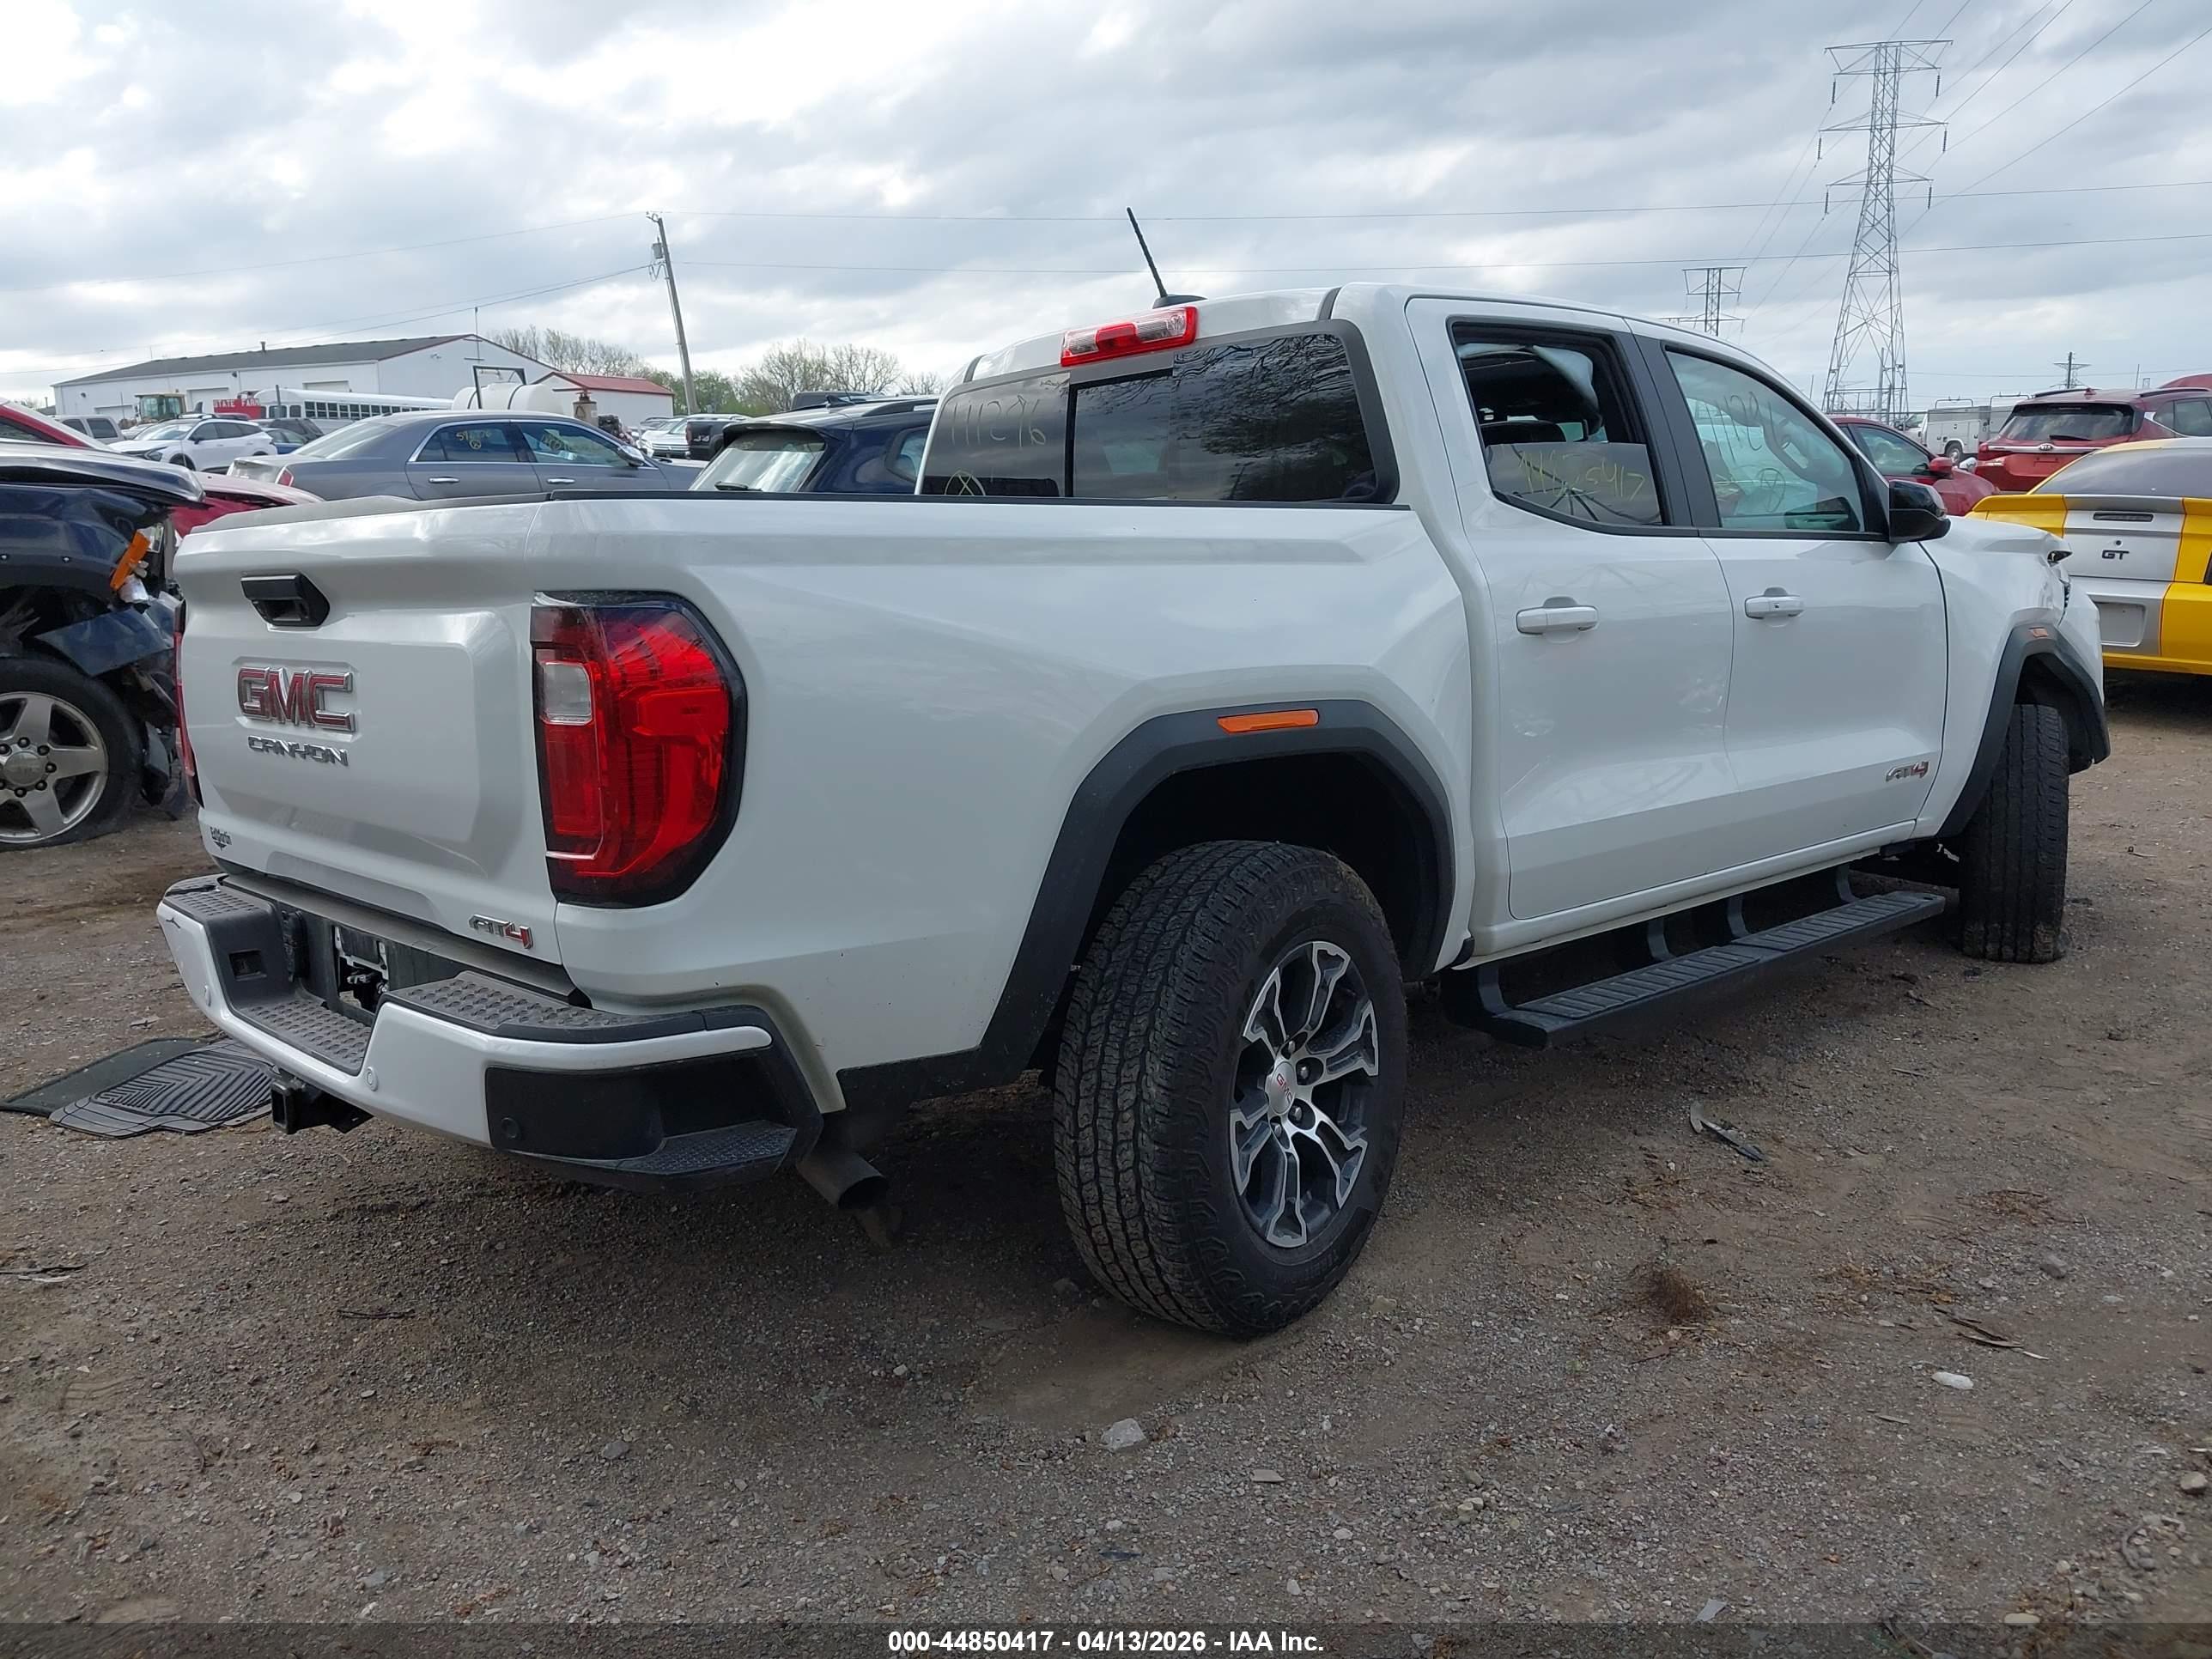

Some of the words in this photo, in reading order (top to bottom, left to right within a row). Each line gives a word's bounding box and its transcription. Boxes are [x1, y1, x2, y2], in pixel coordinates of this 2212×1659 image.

[2101, 550, 2130, 560] GT
[237, 666, 356, 732] GMC
[247, 735, 349, 766] CANYON
[1885, 761, 1929, 782] AT4
[468, 914, 533, 949] AT4
[1276, 1073, 1293, 1104] GMC
